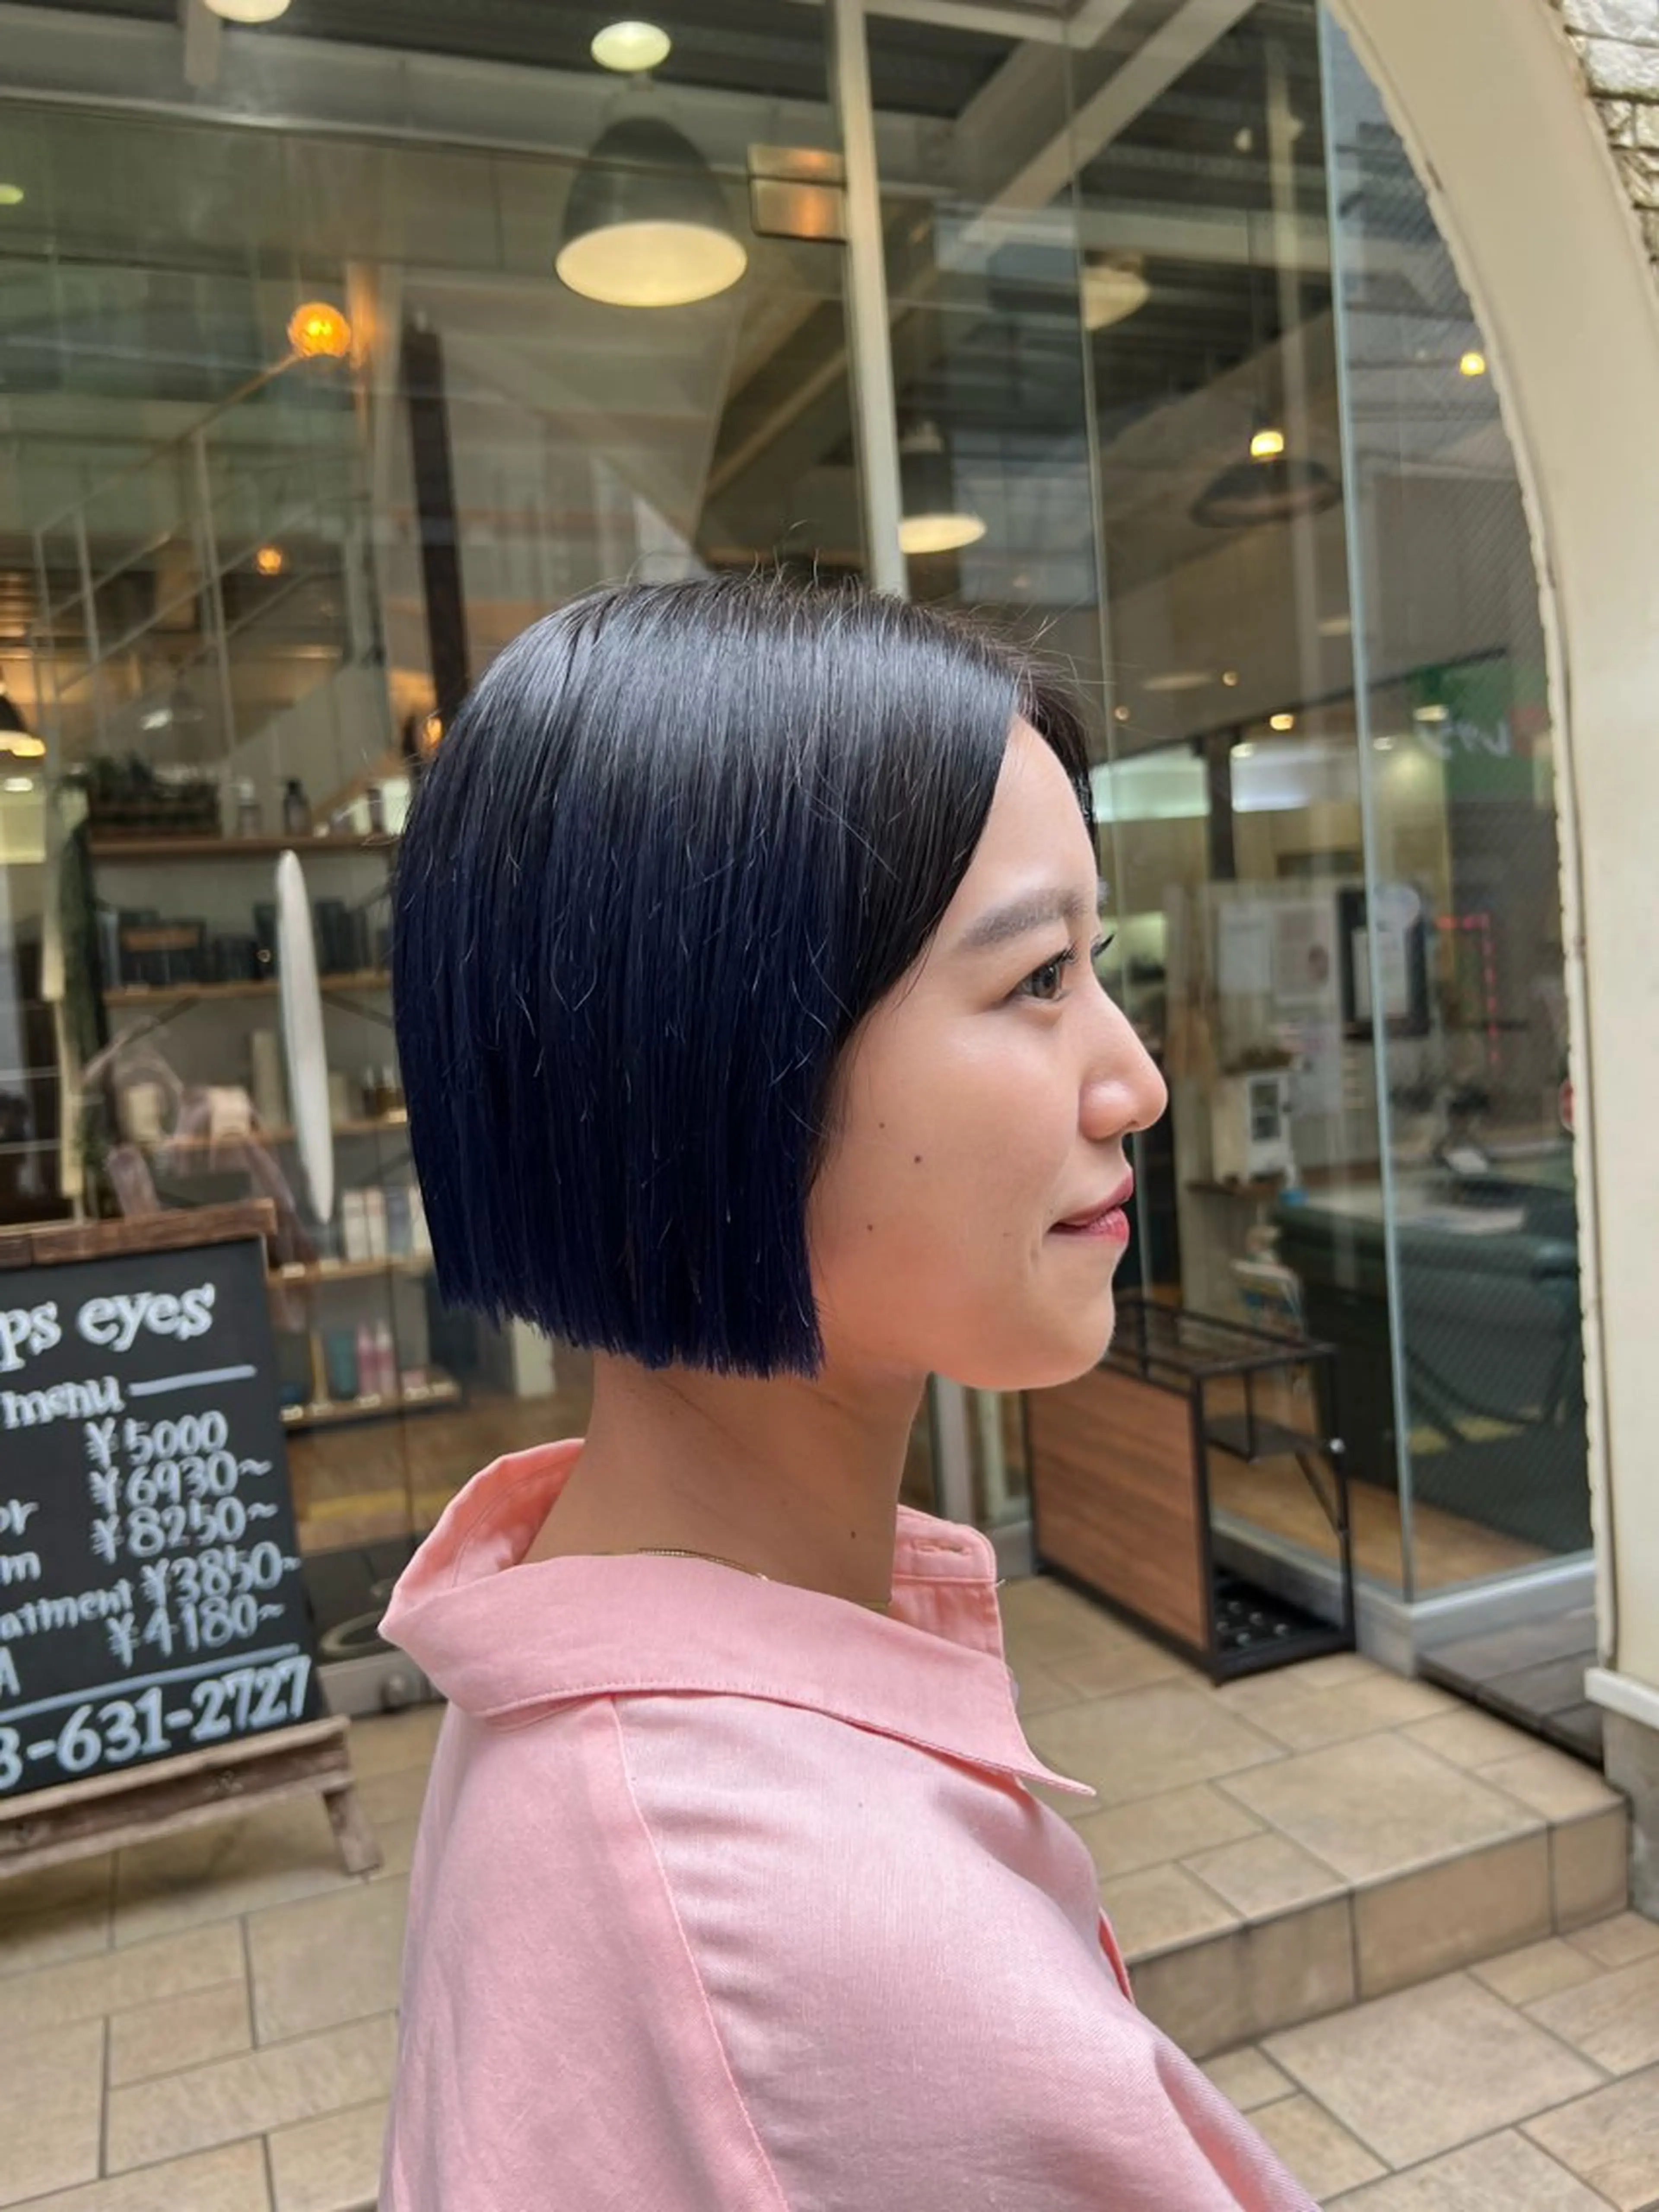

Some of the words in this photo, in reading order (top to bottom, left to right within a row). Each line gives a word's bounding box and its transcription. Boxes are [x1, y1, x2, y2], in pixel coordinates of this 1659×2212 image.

[77, 1282, 215, 1351] eyes
[0, 1376, 125, 1429] menu
[85, 1411, 228, 1468] ¥5000
